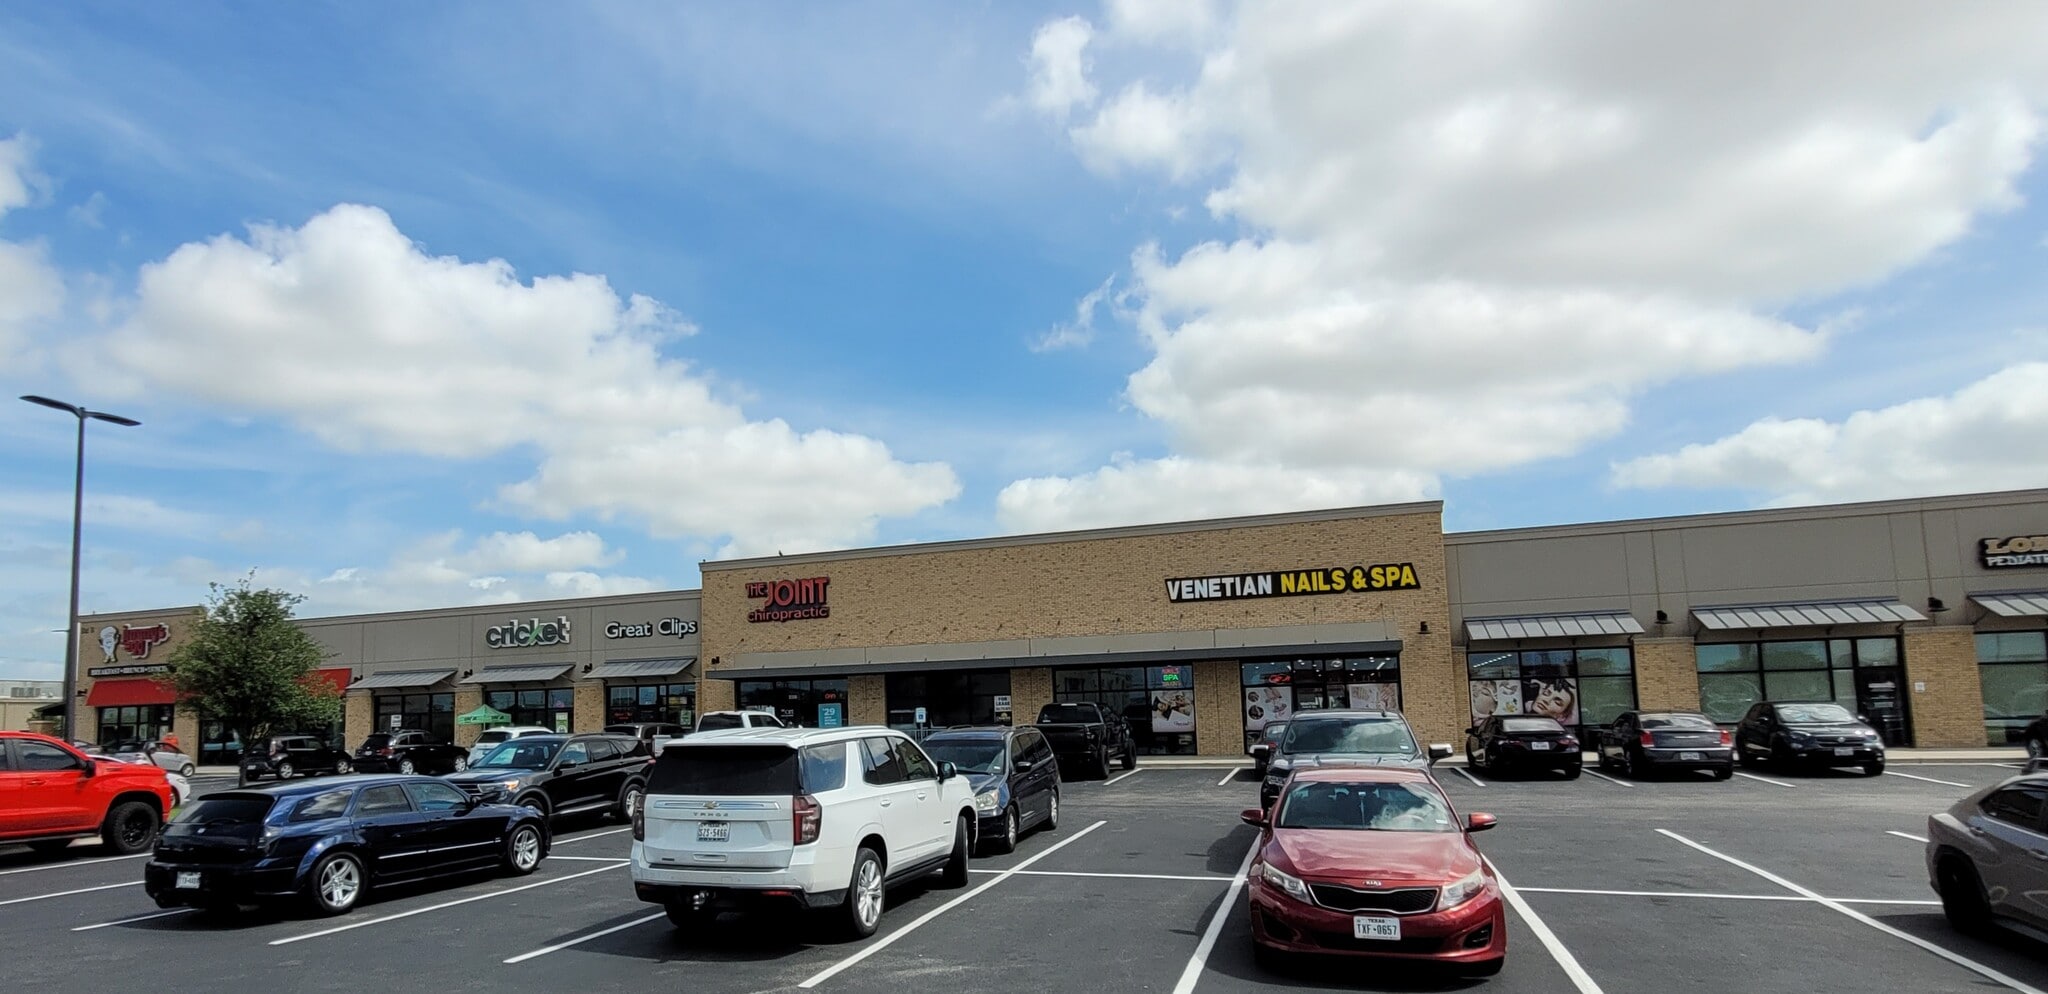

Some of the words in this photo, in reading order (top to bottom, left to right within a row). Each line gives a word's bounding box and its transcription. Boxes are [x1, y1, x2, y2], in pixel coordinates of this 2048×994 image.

[747, 583, 765, 596] THE
[764, 577, 828, 607] JOINT
[1167, 575, 1272, 601] VENETIAN
[1281, 570, 1347, 594] NAILS
[1352, 568, 1367, 590] &
[1371, 565, 1417, 589] SPA
[605, 622, 651, 639] Great
[658, 618, 697, 639] Clips
[749, 606, 828, 622] chiropractic
[486, 616, 570, 648] cricket
